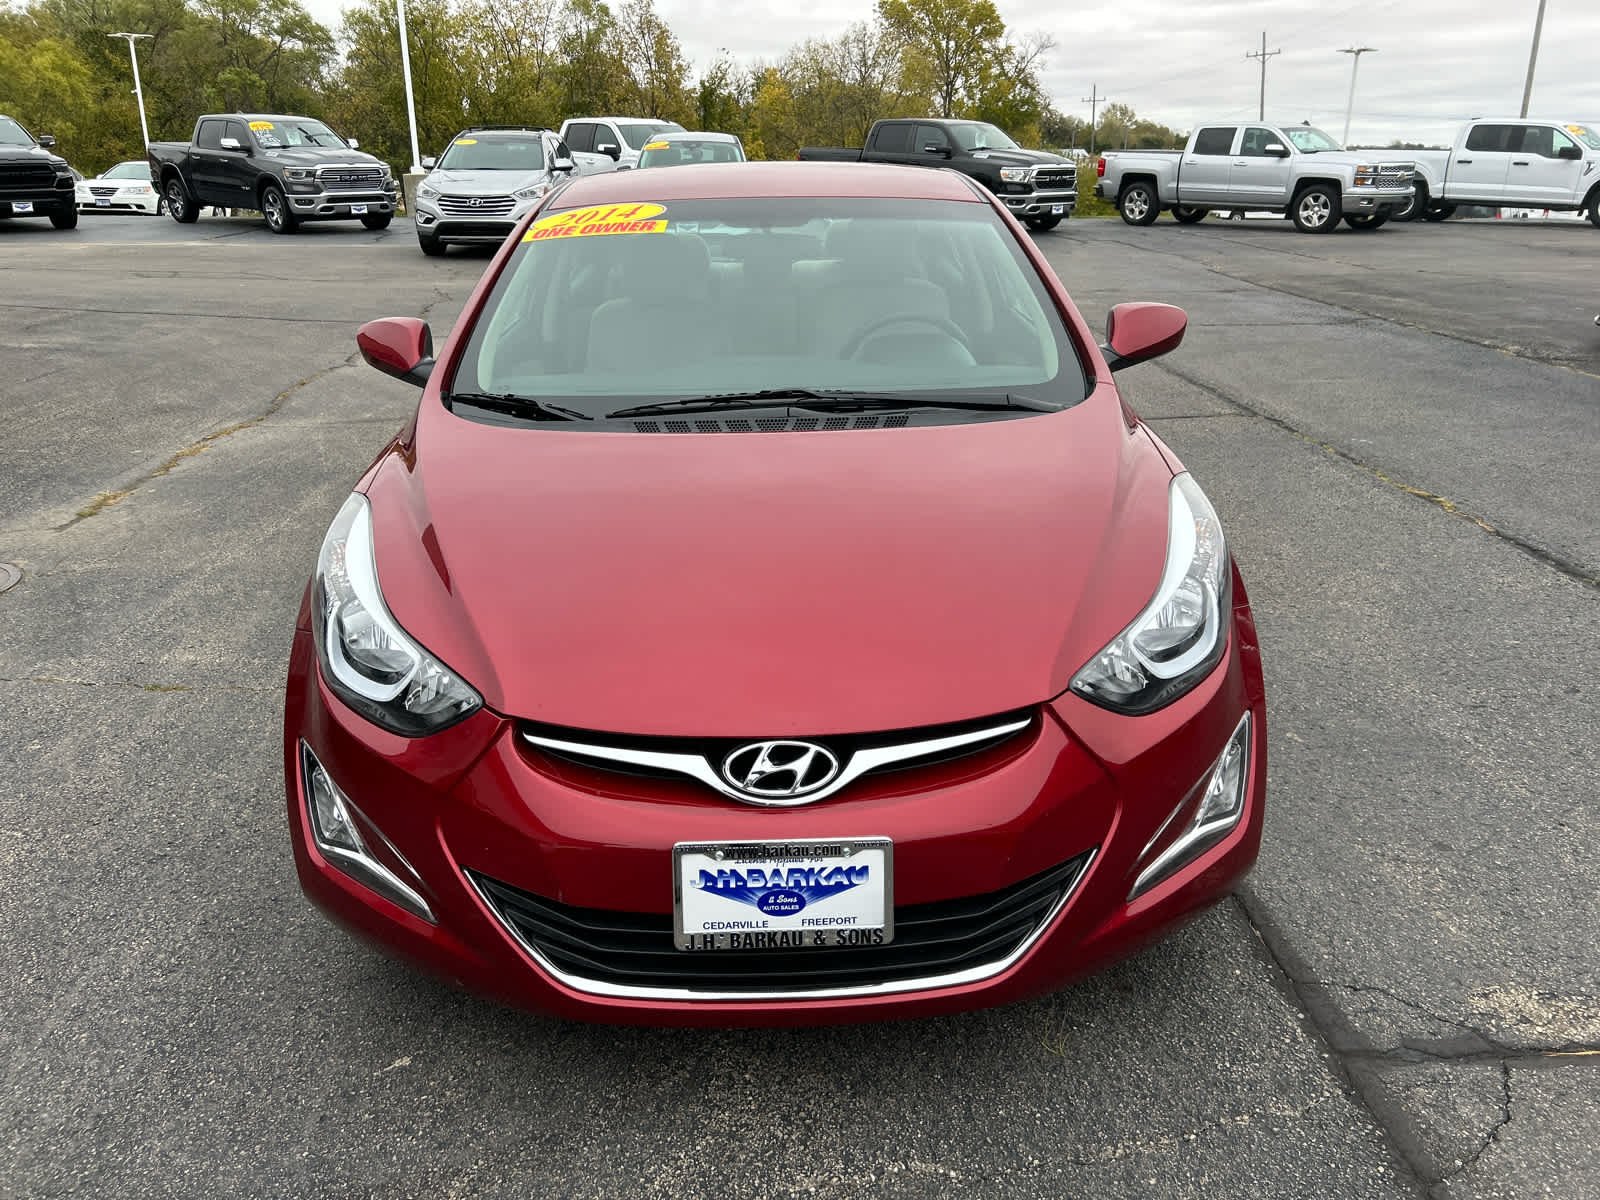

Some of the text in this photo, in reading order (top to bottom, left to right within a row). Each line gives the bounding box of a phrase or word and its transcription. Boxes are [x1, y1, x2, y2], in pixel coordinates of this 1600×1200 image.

[553, 204, 645, 227] 2014
[532, 220, 657, 240] ONE OWNER
[725, 844, 842, 859] www.barkau.com
[776, 894, 798, 904] Sons
[702, 916, 858, 930] CEDARVILLE FREEPORT
[729, 931, 803, 949] BARKAU
[813, 929, 827, 945] &
[836, 928, 884, 945] SONS
